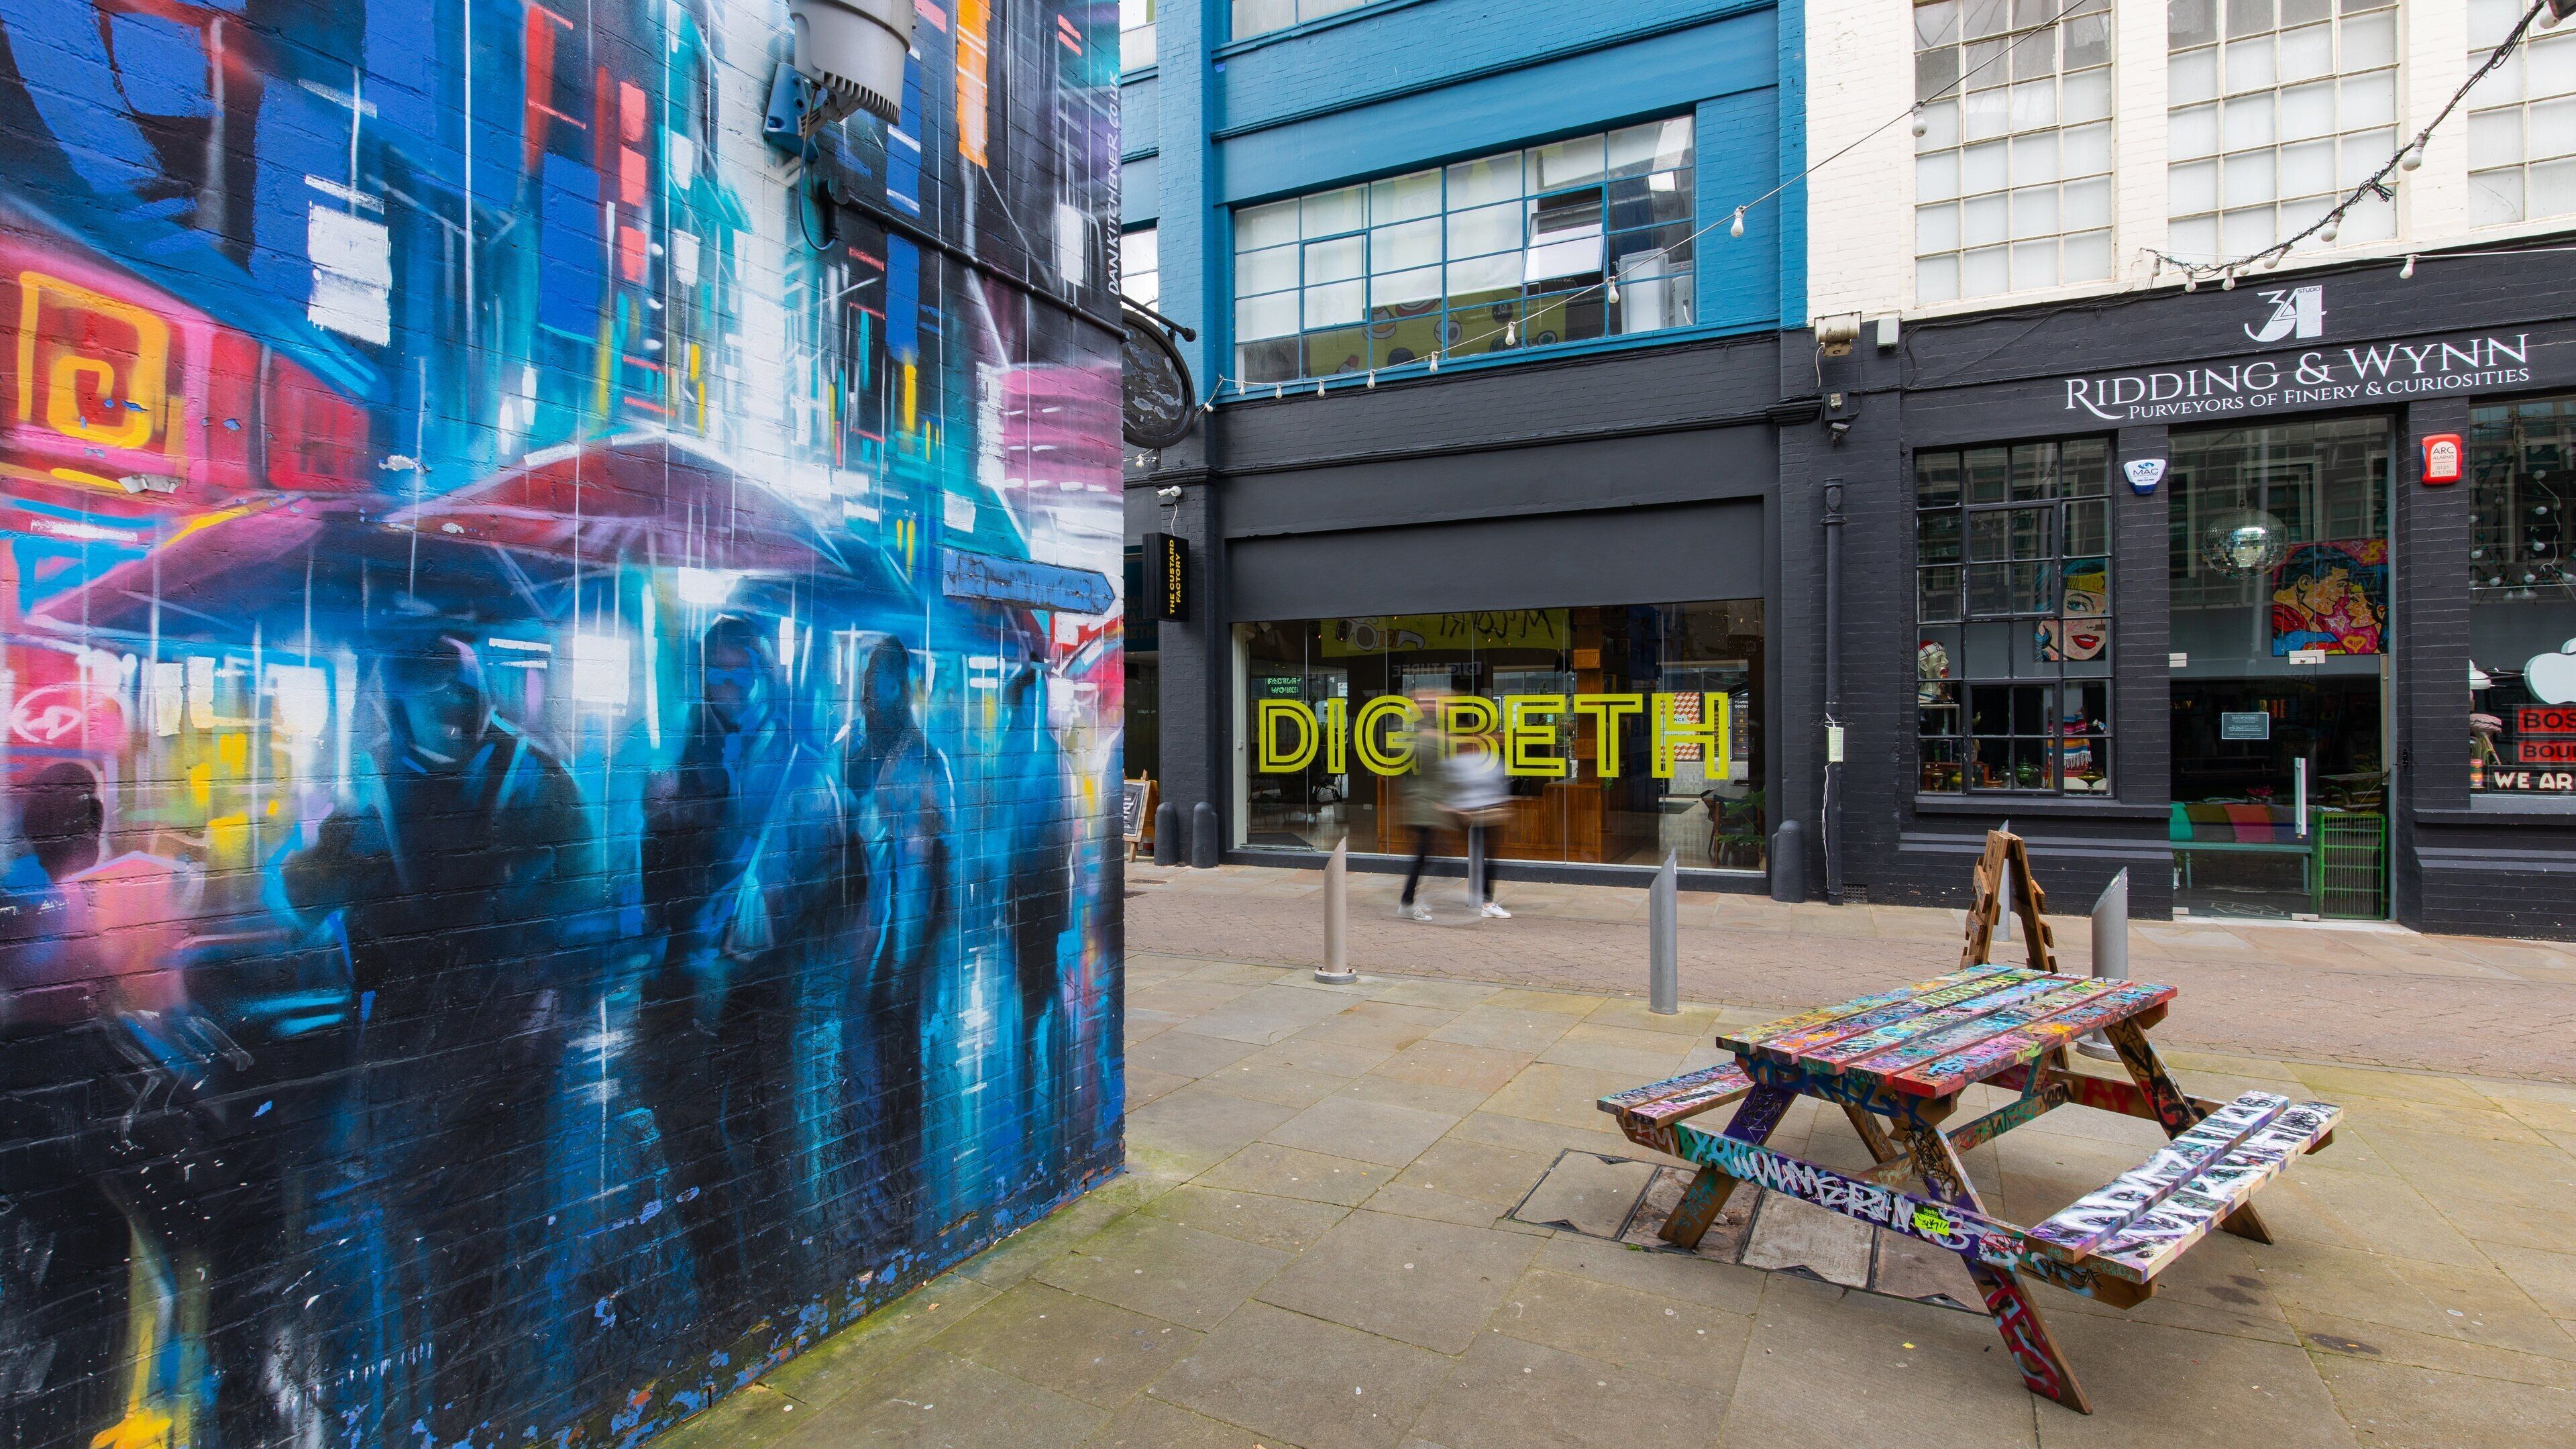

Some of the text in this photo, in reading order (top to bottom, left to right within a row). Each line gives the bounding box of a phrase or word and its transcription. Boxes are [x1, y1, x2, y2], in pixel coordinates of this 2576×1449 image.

[2064, 333, 2530, 421] RIDDING & WYNN
[2129, 367, 2530, 420] PURVEYORS OF FINERY & CURIOSITIES
[2432, 446, 2455, 455] ARC
[2133, 468, 2159, 476] MAC
[1258, 692, 1729, 780] DIGBETH
[2522, 745, 2576, 759] BOU
[2493, 772, 2573, 790] WE AR
[1923, 1207, 1939, 1216] Hello
